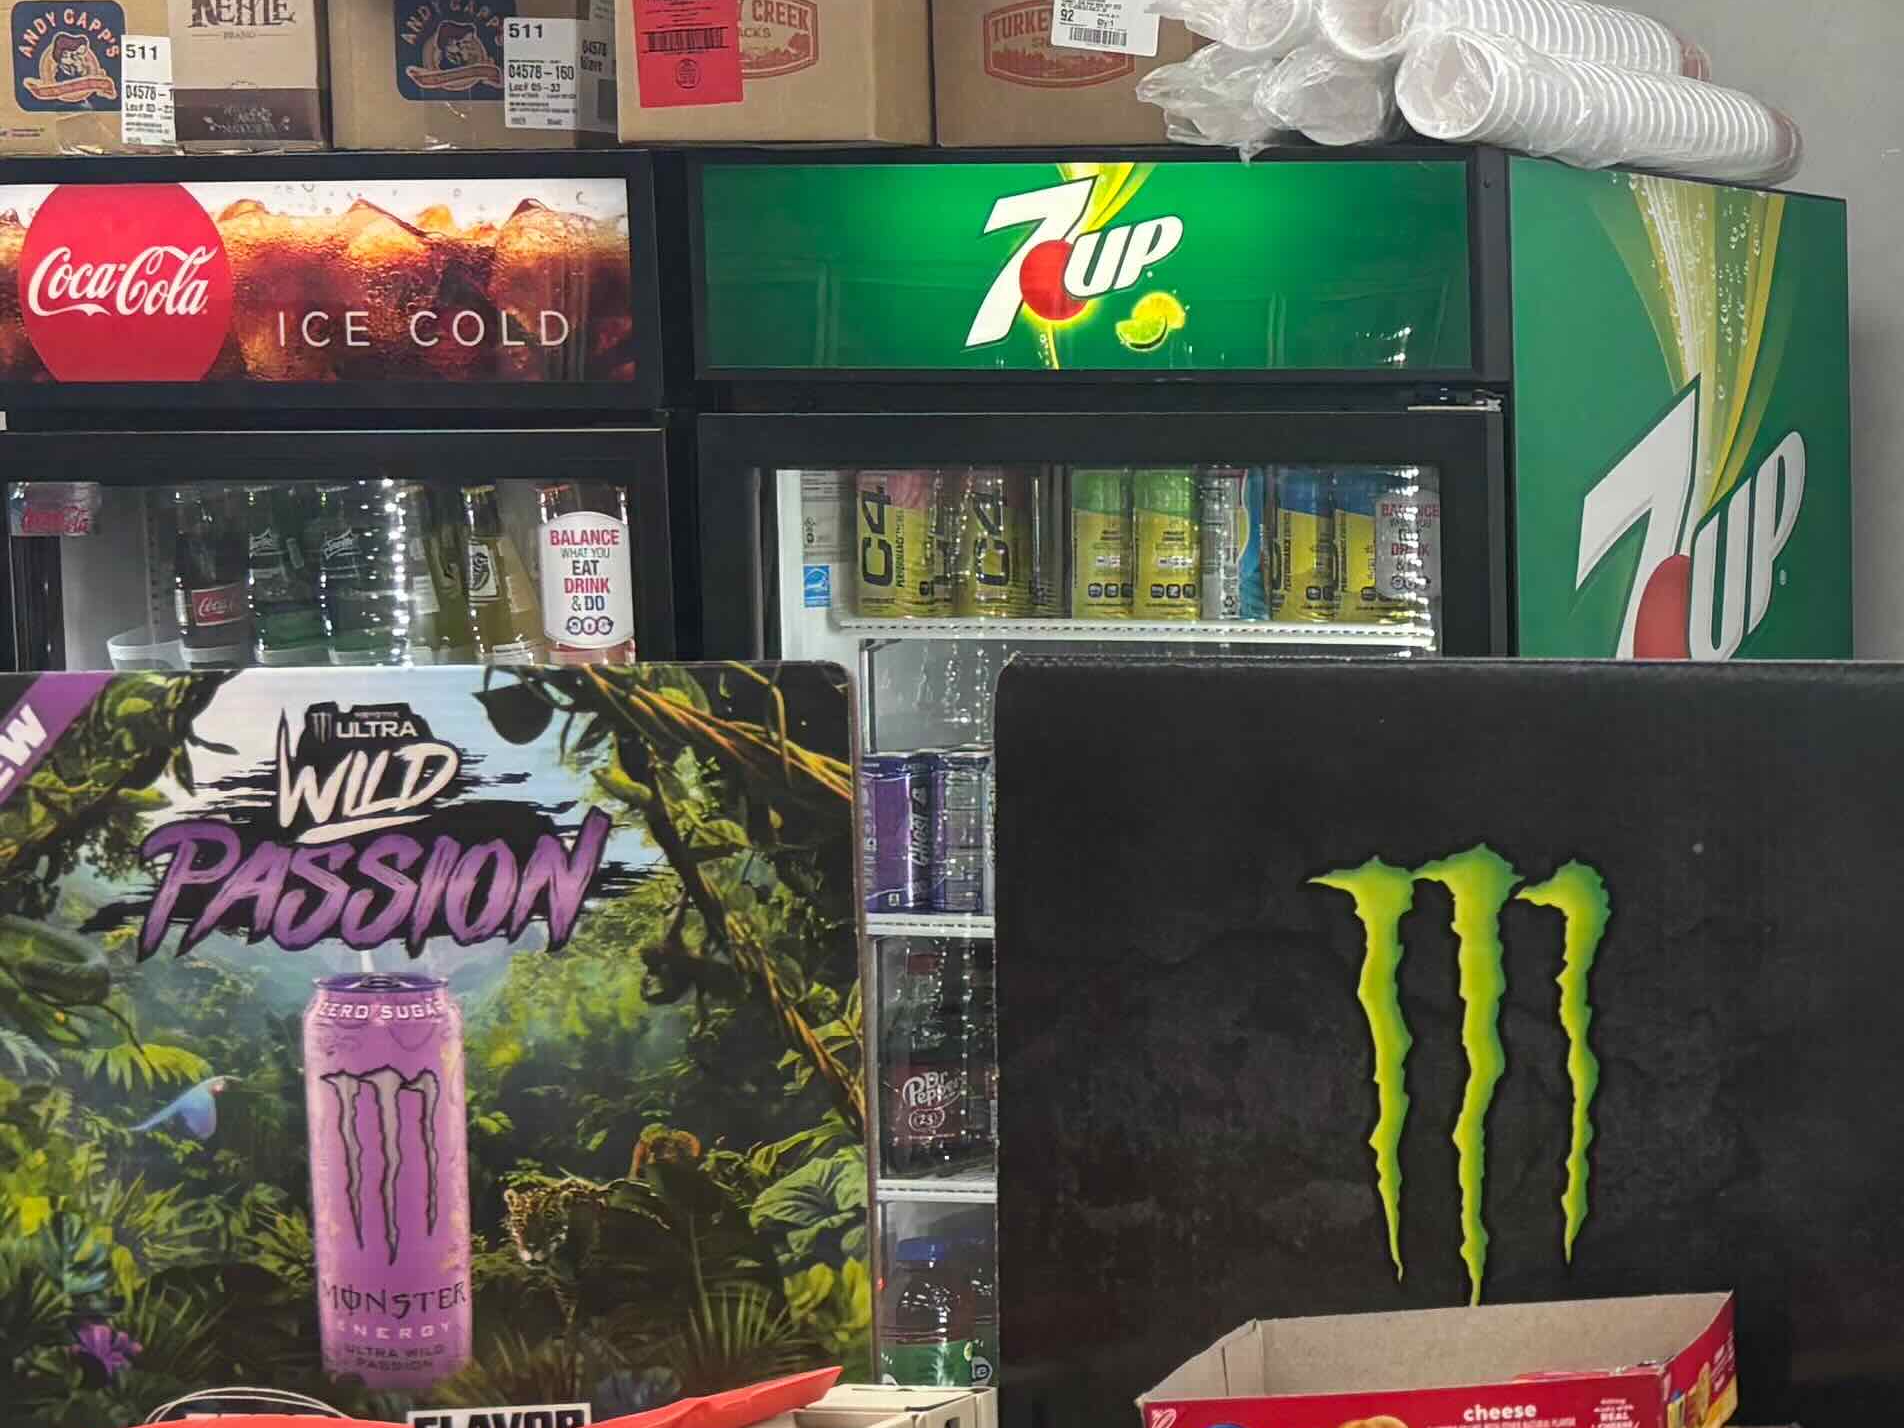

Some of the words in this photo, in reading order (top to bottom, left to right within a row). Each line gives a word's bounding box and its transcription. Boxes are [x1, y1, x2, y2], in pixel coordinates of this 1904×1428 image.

[752, 0, 810, 31] CREEK
[20, 12, 56, 59] ANDY
[63, 8, 121, 59] CAPP'S
[509, 23, 544, 39] 511
[126, 43, 159, 61] 511
[964, 175, 1184, 352] 7UP
[27, 244, 219, 318] Coca-Cola
[279, 311, 370, 348] ICE
[410, 311, 570, 348] COLD
[549, 529, 620, 546] BALANCE
[561, 548, 588, 559] WHAT
[591, 547, 611, 559] YOU
[572, 560, 600, 576] EAT
[564, 578, 610, 594] DRINK
[584, 595, 606, 612] DO
[336, 721, 418, 739] ULTRA
[279, 708, 459, 828] WILD
[139, 806, 613, 963] PASSION
[317, 1000, 372, 1023] ZERO
[924, 1070, 949, 1092] Dr
[324, 1279, 468, 1318] MONSTER
[335, 1319, 454, 1341] ENERGY
[1462, 1404, 1537, 1422] cheese
